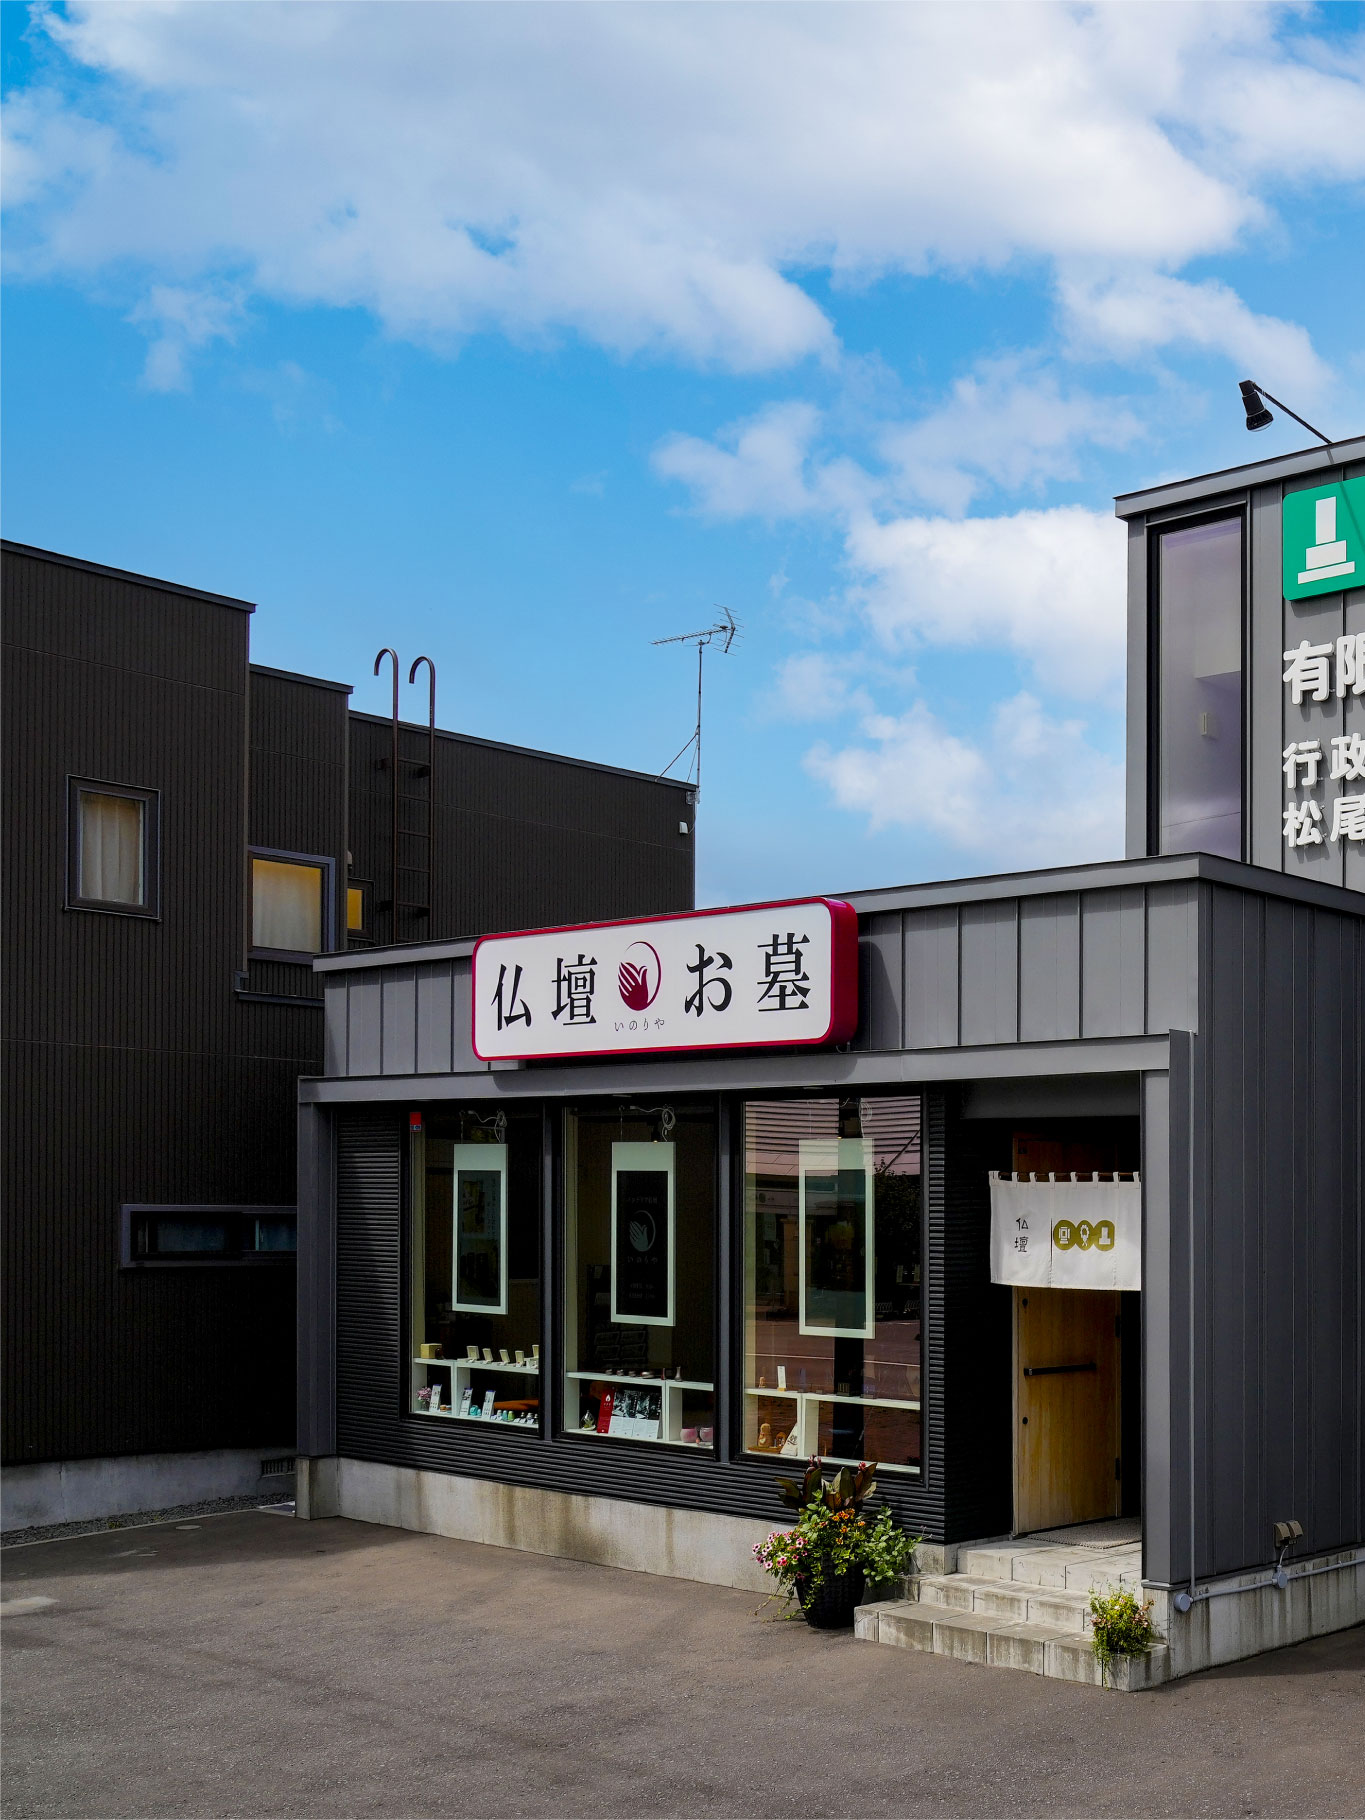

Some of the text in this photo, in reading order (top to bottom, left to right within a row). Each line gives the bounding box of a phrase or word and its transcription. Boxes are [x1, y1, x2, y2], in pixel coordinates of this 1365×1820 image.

[491, 932, 811, 1031] 仏壇 お墓
[614, 1018, 665, 1032] いのりや
[1014, 1217, 1029, 1253] 仏壇
